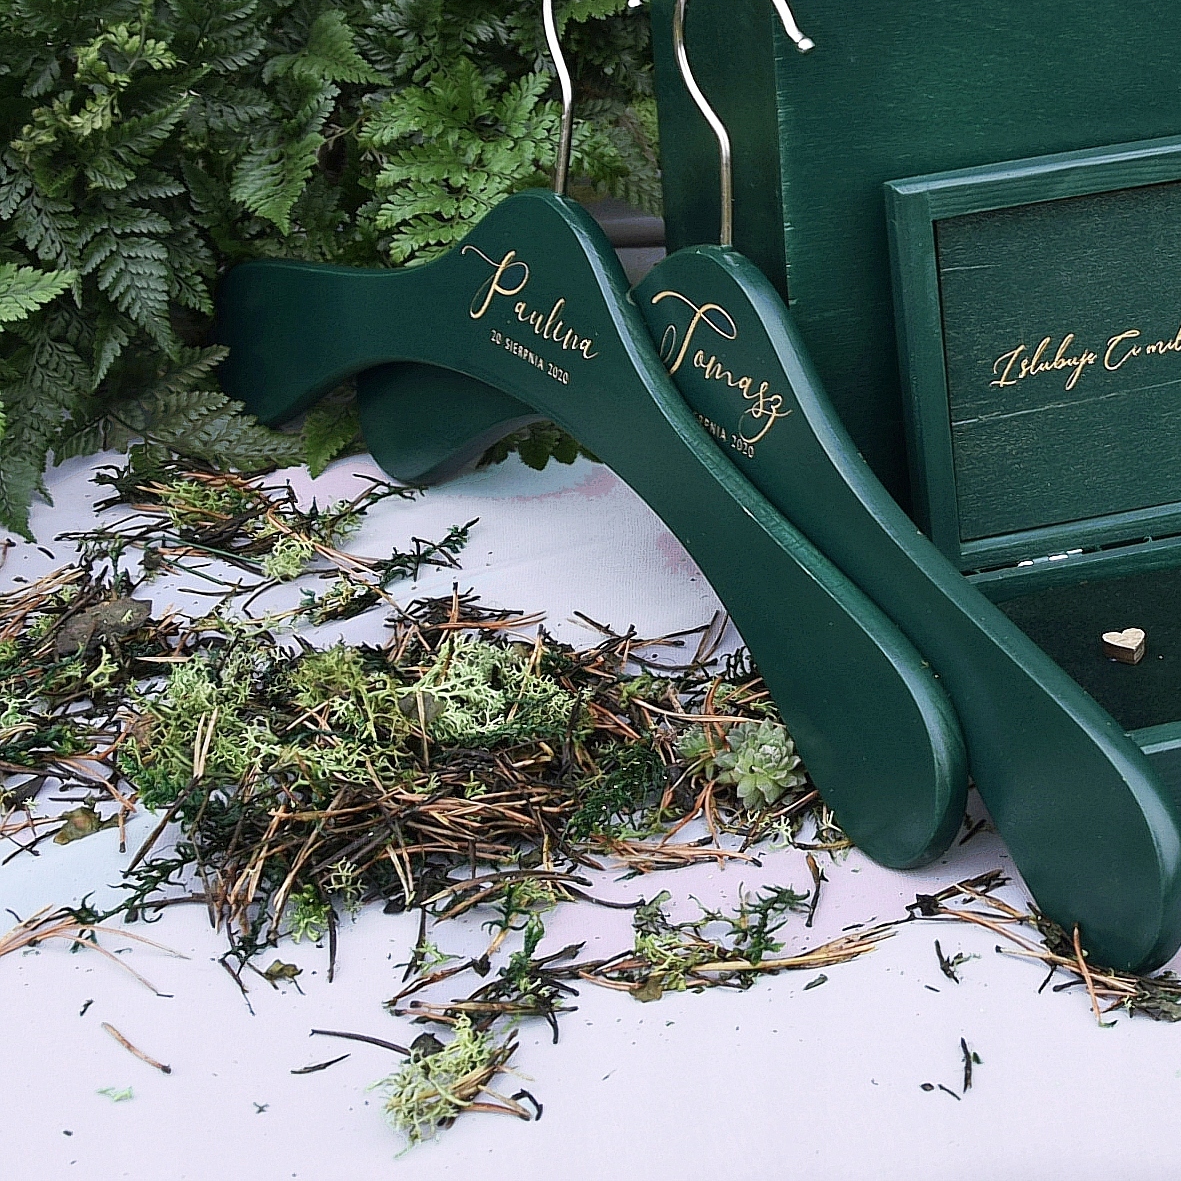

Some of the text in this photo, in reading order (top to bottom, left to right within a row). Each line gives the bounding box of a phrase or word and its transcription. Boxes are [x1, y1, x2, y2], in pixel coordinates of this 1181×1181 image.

[461, 244, 599, 360] Paulina
[490, 329, 570, 385] 20 SIERPNIA 2020
[651, 290, 793, 444] Tomasz
[730, 434, 755, 458] 2020
